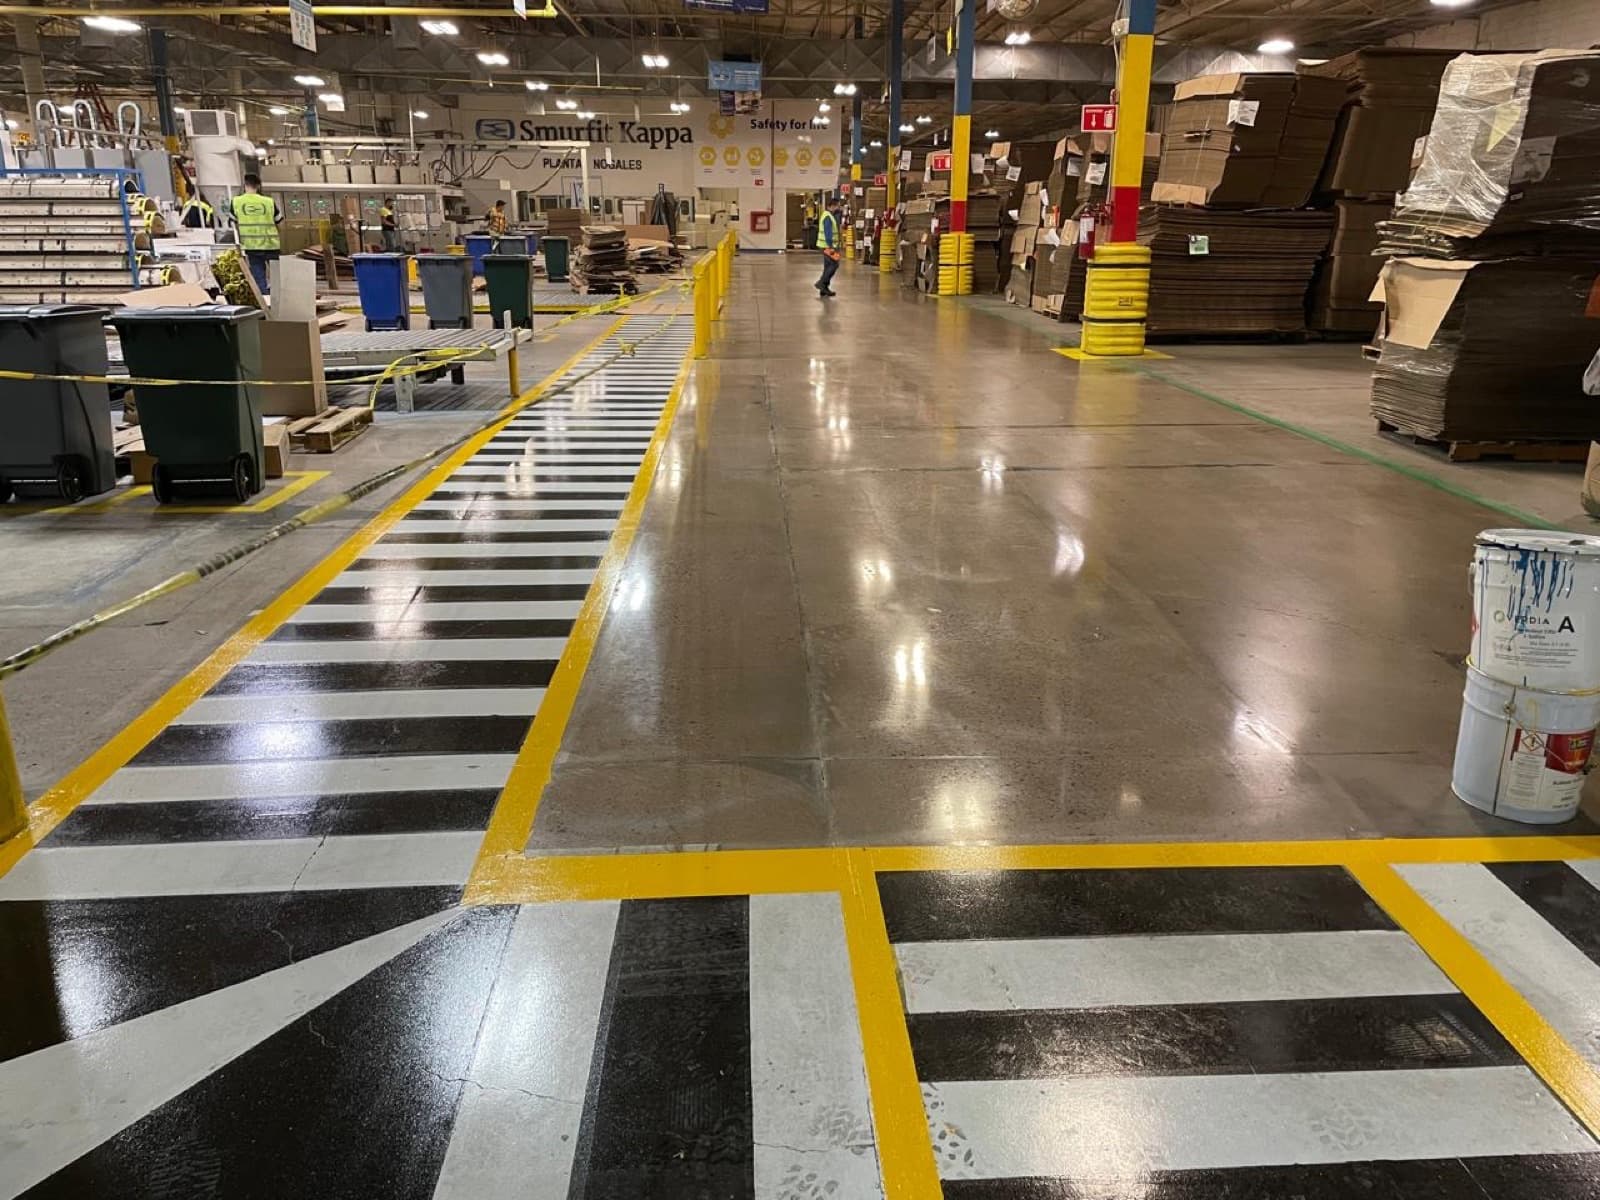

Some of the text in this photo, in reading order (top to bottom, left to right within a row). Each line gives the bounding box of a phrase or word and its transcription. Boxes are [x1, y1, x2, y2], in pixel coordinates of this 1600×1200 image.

[750, 118, 787, 131] Safety
[789, 118, 807, 130] for
[519, 119, 694, 150] Smurfit Kappa
[543, 158, 642, 170] PLANTA NOGALES
[1557, 615, 1575, 633] A
